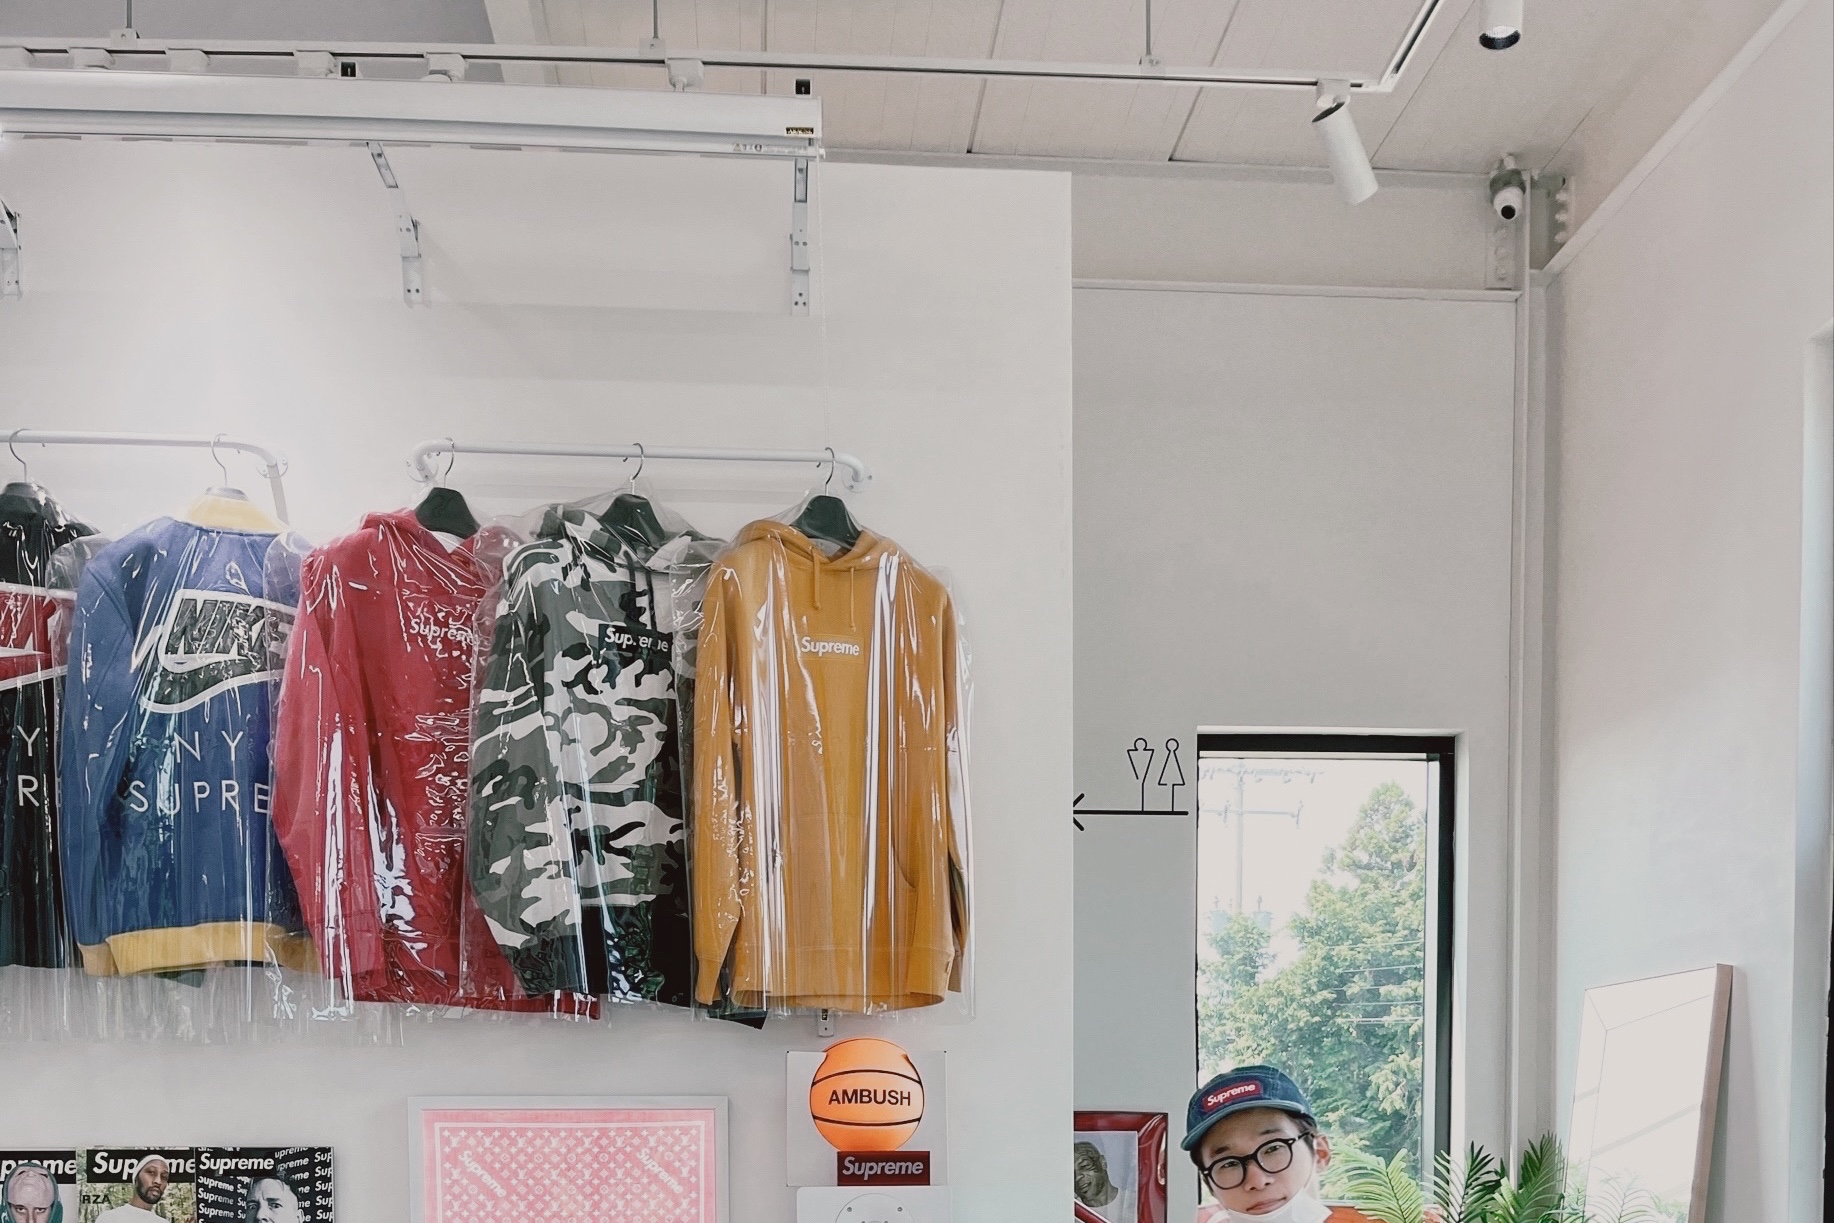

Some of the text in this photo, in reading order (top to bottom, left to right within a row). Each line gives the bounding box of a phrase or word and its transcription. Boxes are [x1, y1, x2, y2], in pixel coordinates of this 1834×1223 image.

[605, 627, 669, 652] Supeme
[801, 636, 860, 657] Supreme
[828, 1088, 911, 1107] AMBUSH
[1208, 1082, 1256, 1106] Supreme
[93, 1152, 195, 1180] Supme
[199, 1153, 275, 1175] Supreme
[458, 1150, 508, 1198] Supreme
[636, 1148, 684, 1195] Supreme
[842, 1157, 924, 1180] Supreme
